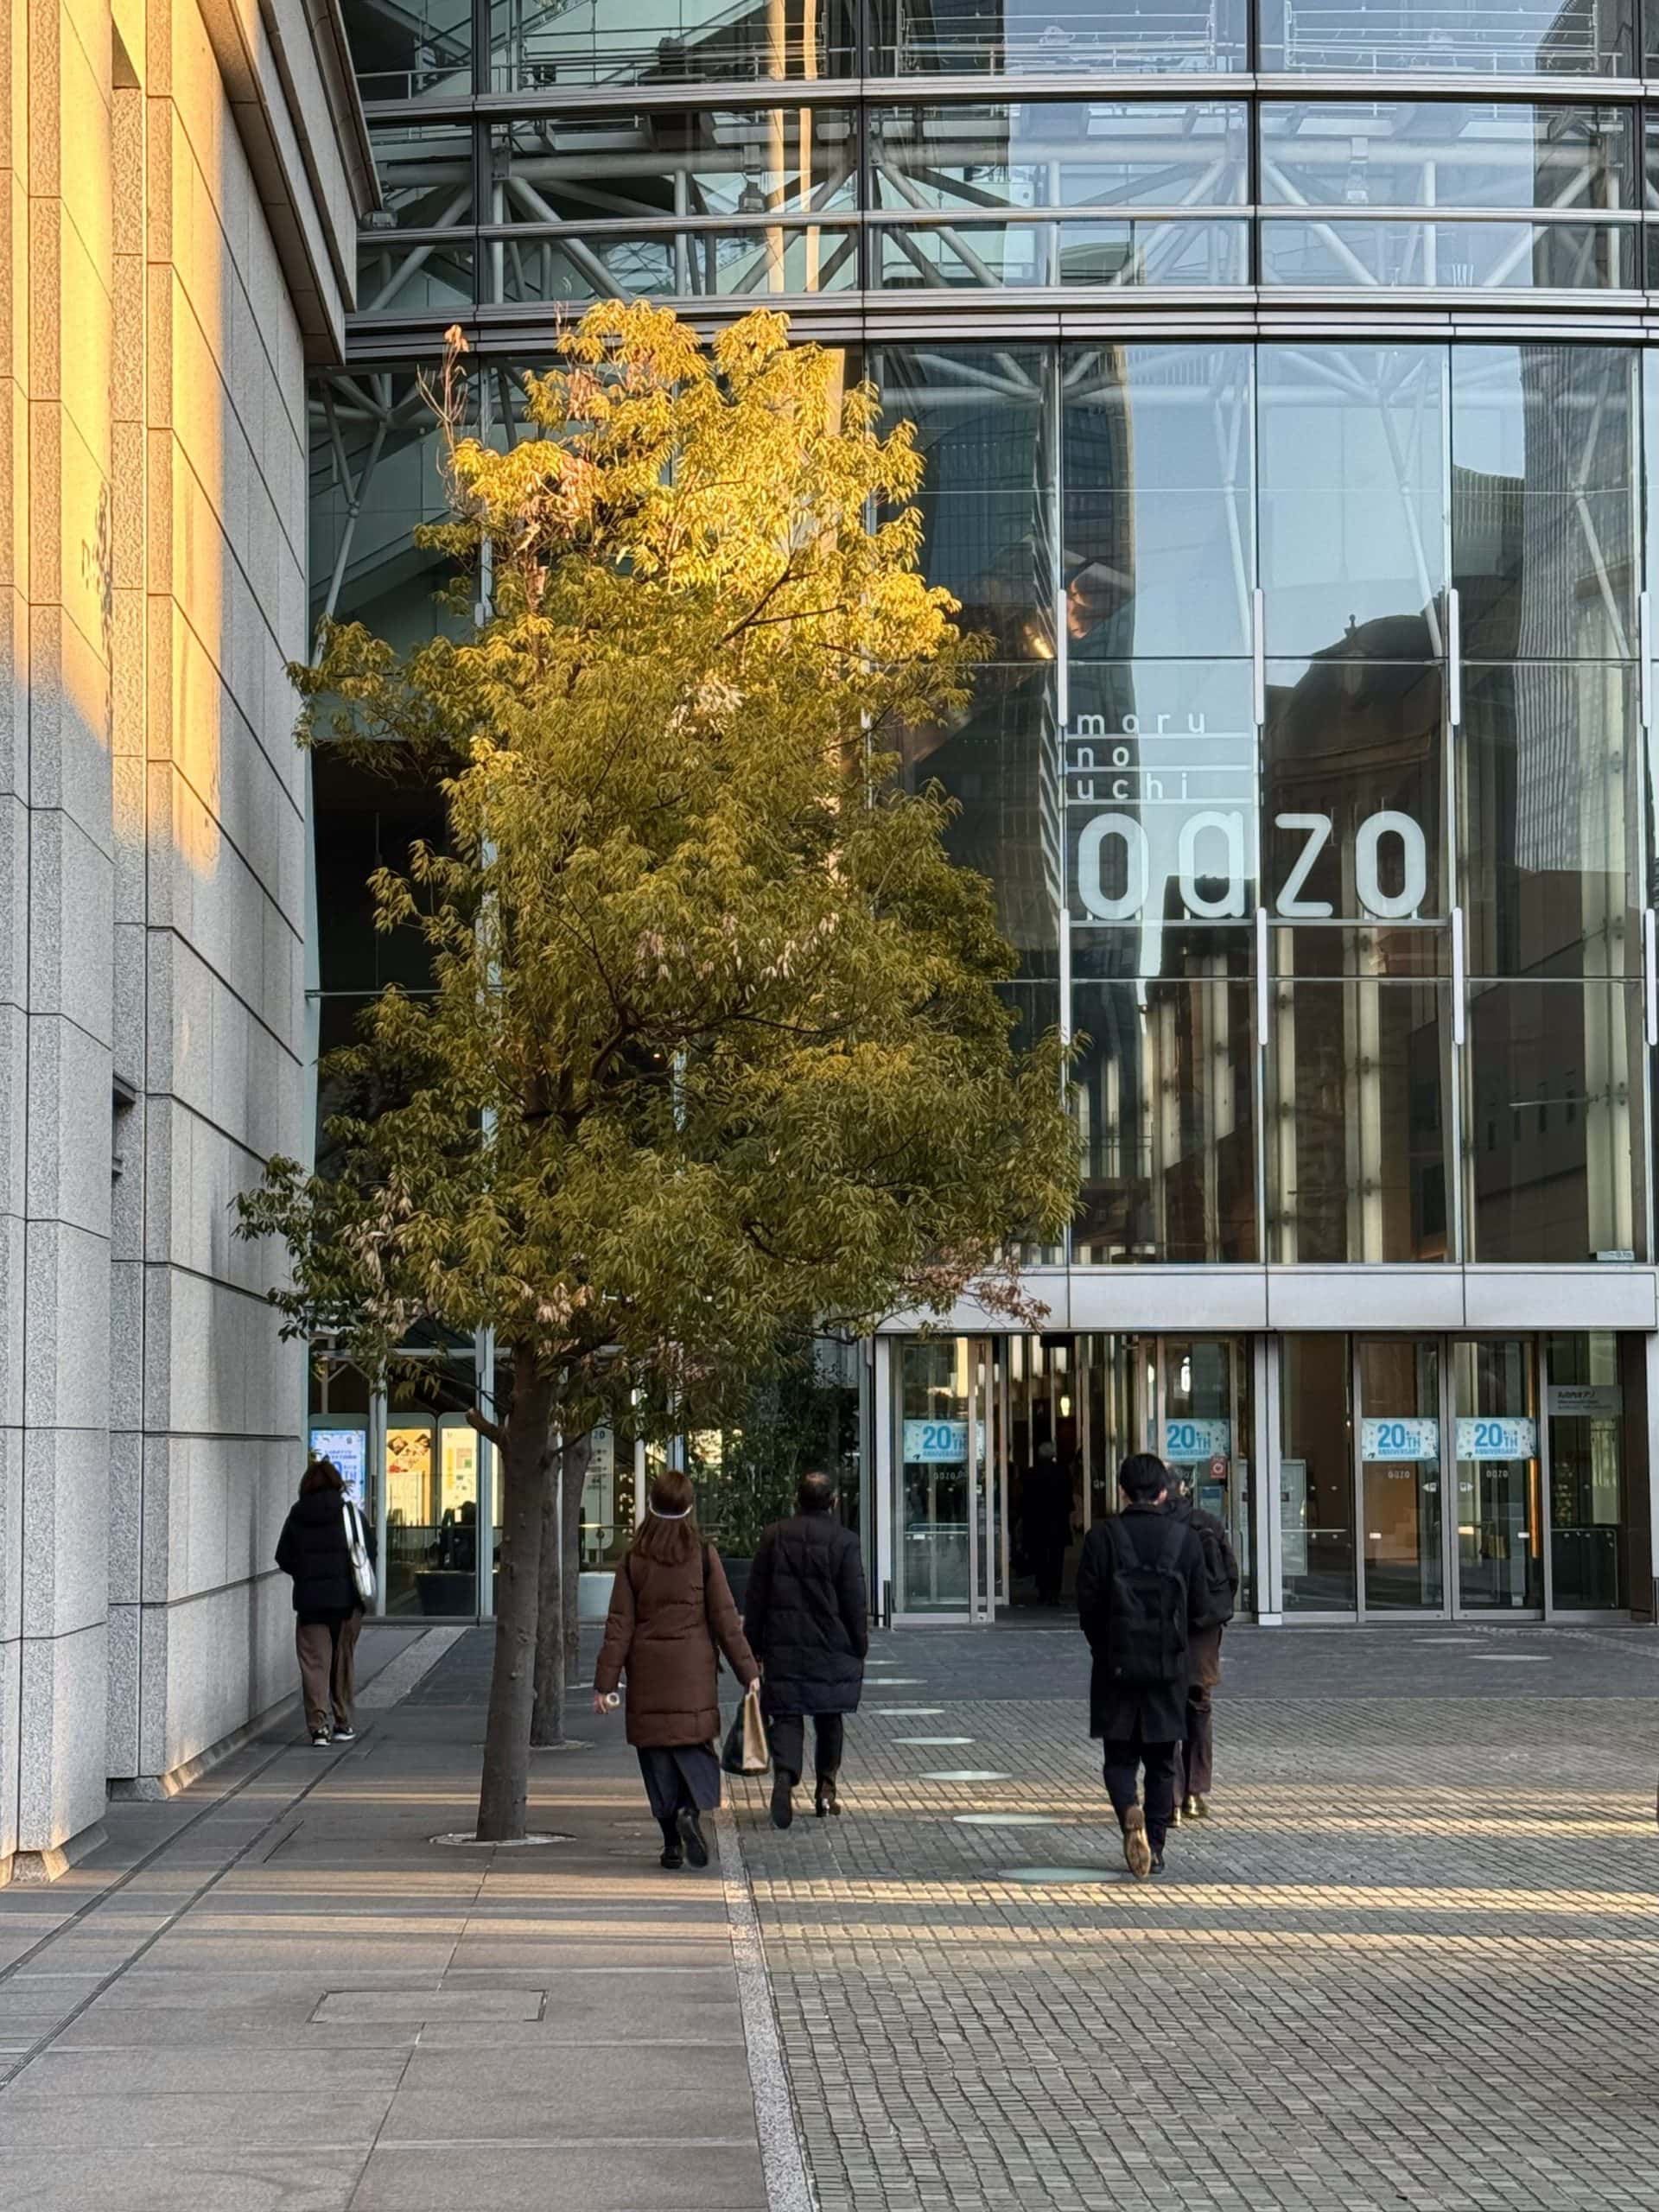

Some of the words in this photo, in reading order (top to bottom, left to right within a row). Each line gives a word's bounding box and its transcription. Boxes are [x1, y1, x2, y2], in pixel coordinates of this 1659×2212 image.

[1077, 713, 1205, 734] maru
[1077, 747, 1129, 766] no
[1077, 772, 1188, 799] uchi
[1077, 810, 1427, 920] oazo
